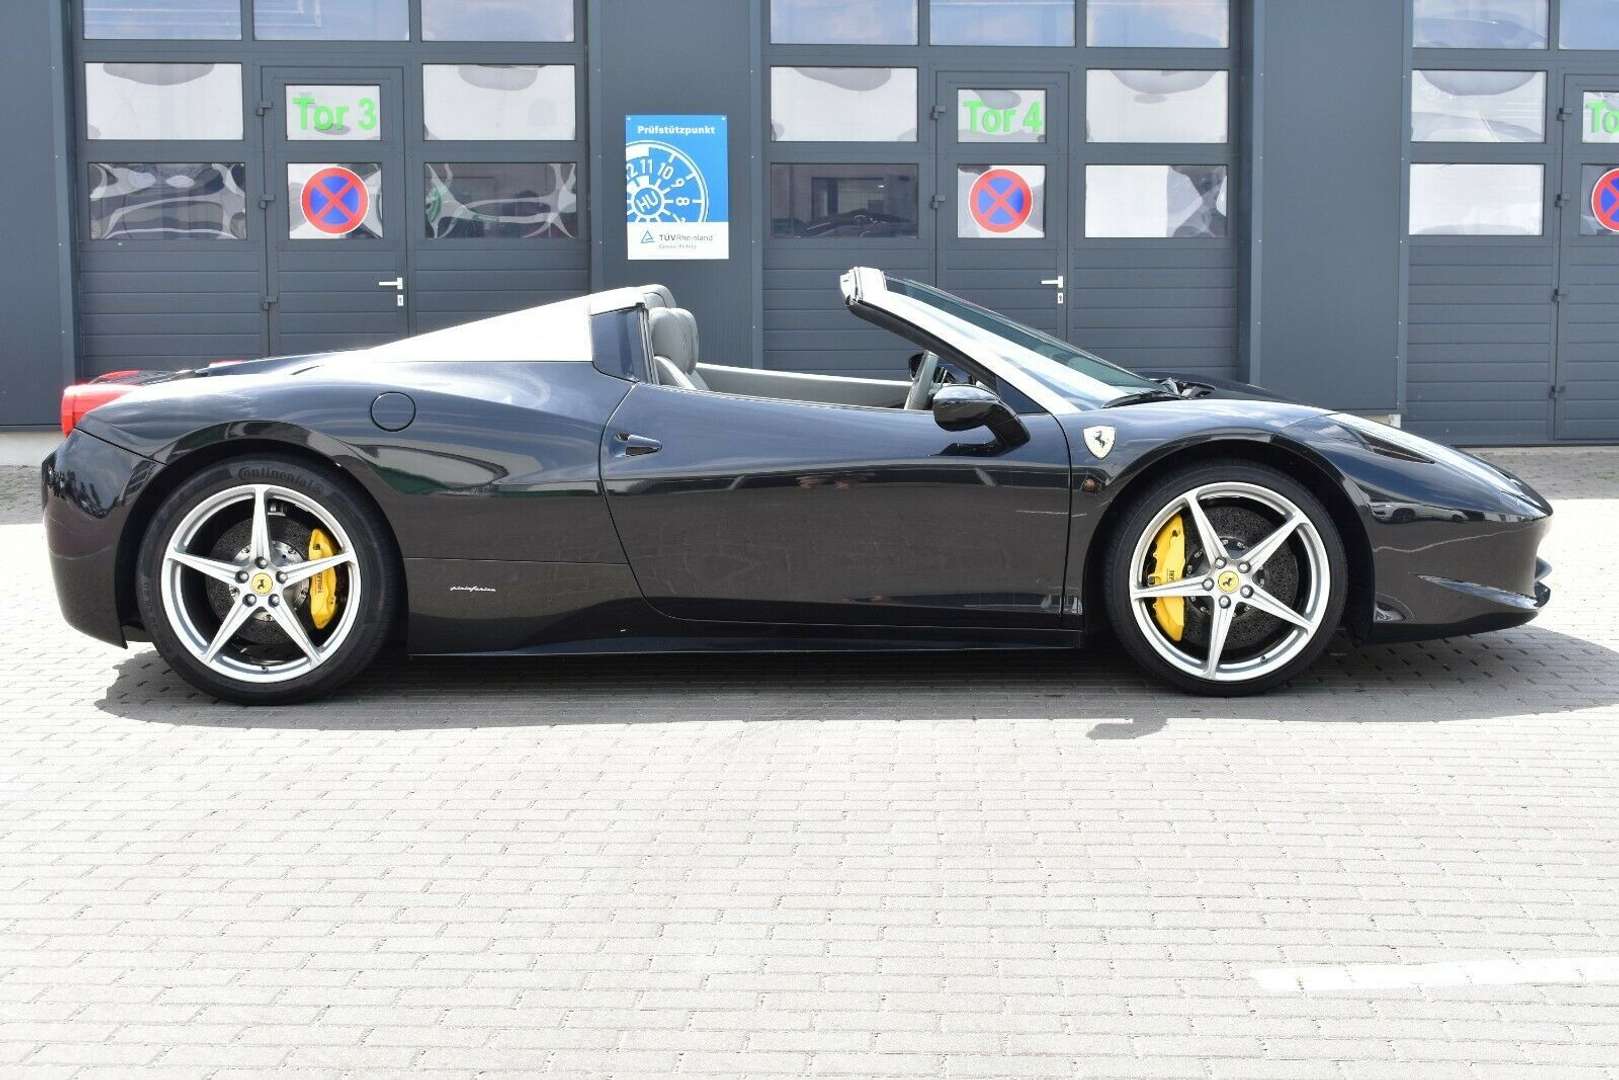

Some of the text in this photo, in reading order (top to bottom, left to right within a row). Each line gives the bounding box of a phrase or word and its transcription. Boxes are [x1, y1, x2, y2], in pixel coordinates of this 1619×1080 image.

[292, 96, 377, 131] Tor 3
[963, 100, 1041, 134] Tor 4
[637, 125, 716, 136] Prüfstützpunkt
[640, 158, 653, 174] 11
[658, 162, 674, 180] 10
[671, 178, 685, 188] 9
[636, 190, 659, 213] HU
[675, 197, 690, 206] 8
